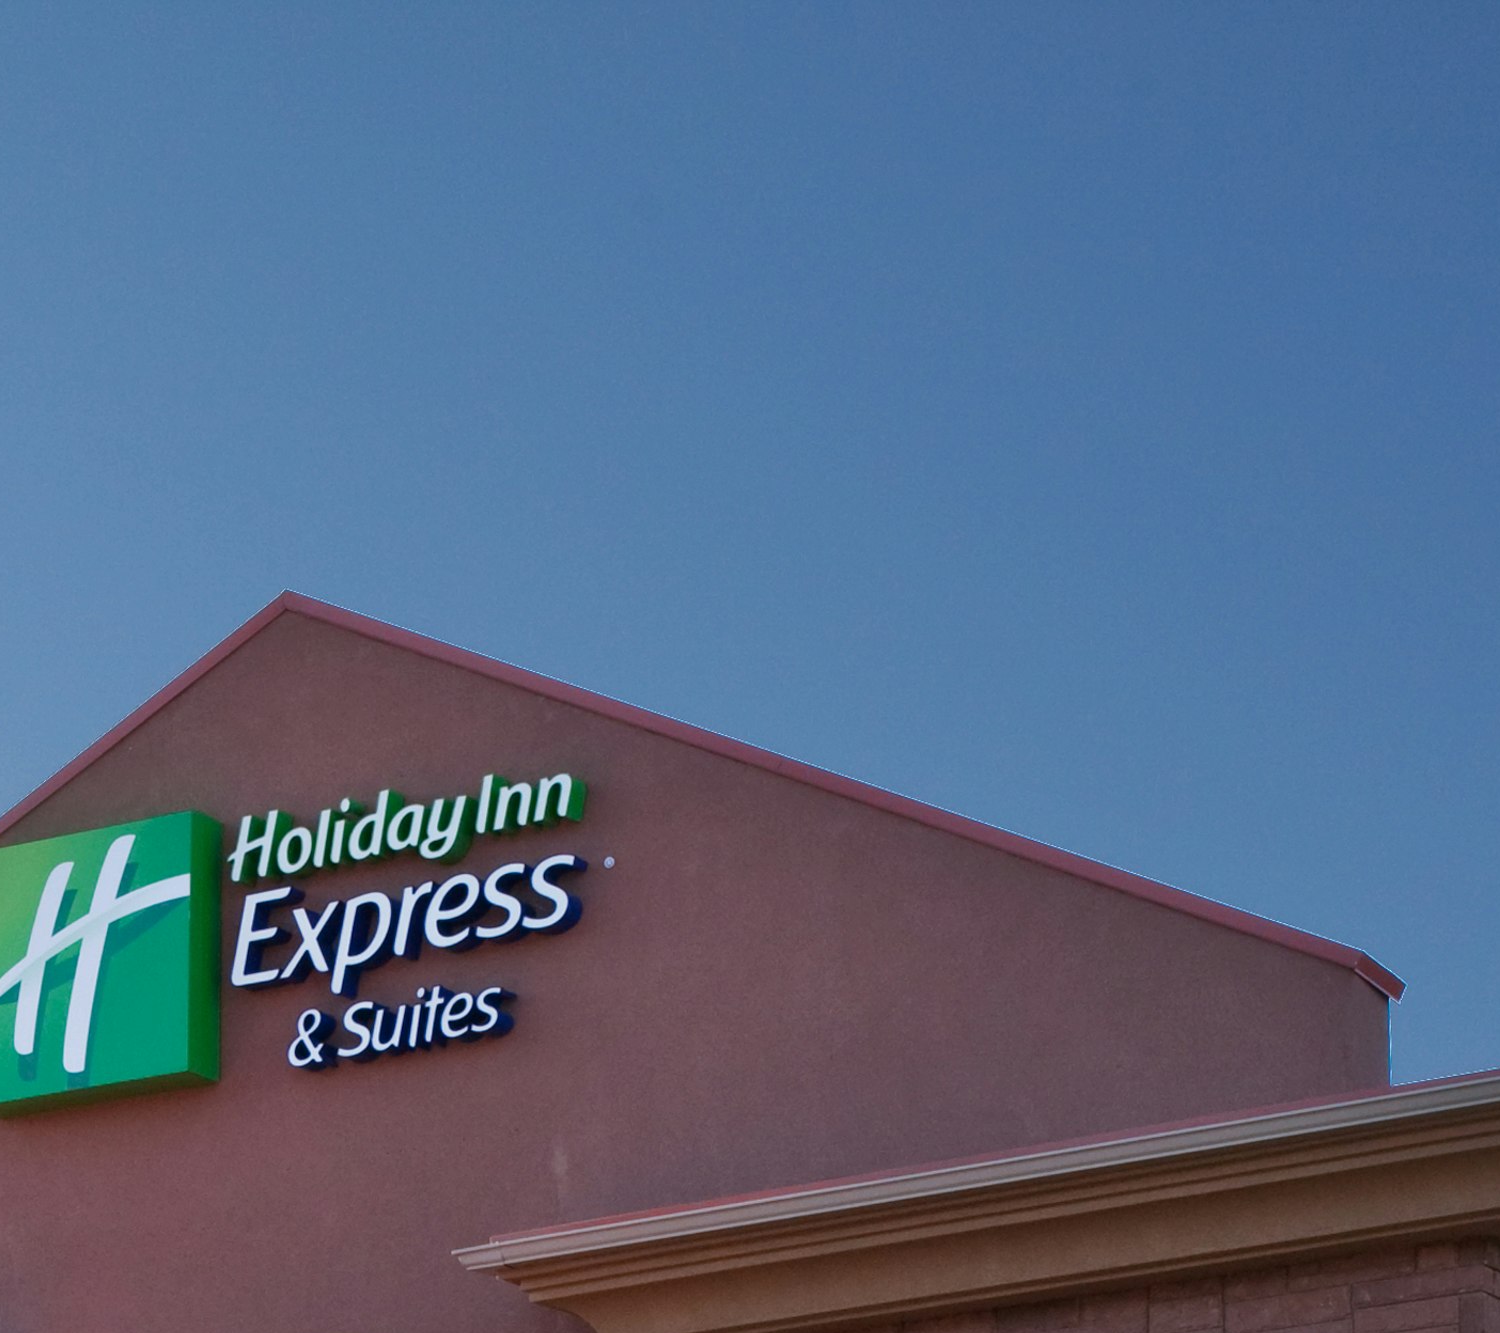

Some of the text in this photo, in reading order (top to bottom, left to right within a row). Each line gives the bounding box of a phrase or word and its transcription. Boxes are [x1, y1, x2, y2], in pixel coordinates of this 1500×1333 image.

[227, 772, 577, 883] Holiday Inn
[230, 853, 578, 995] Express
[287, 984, 503, 1068] & Suites
